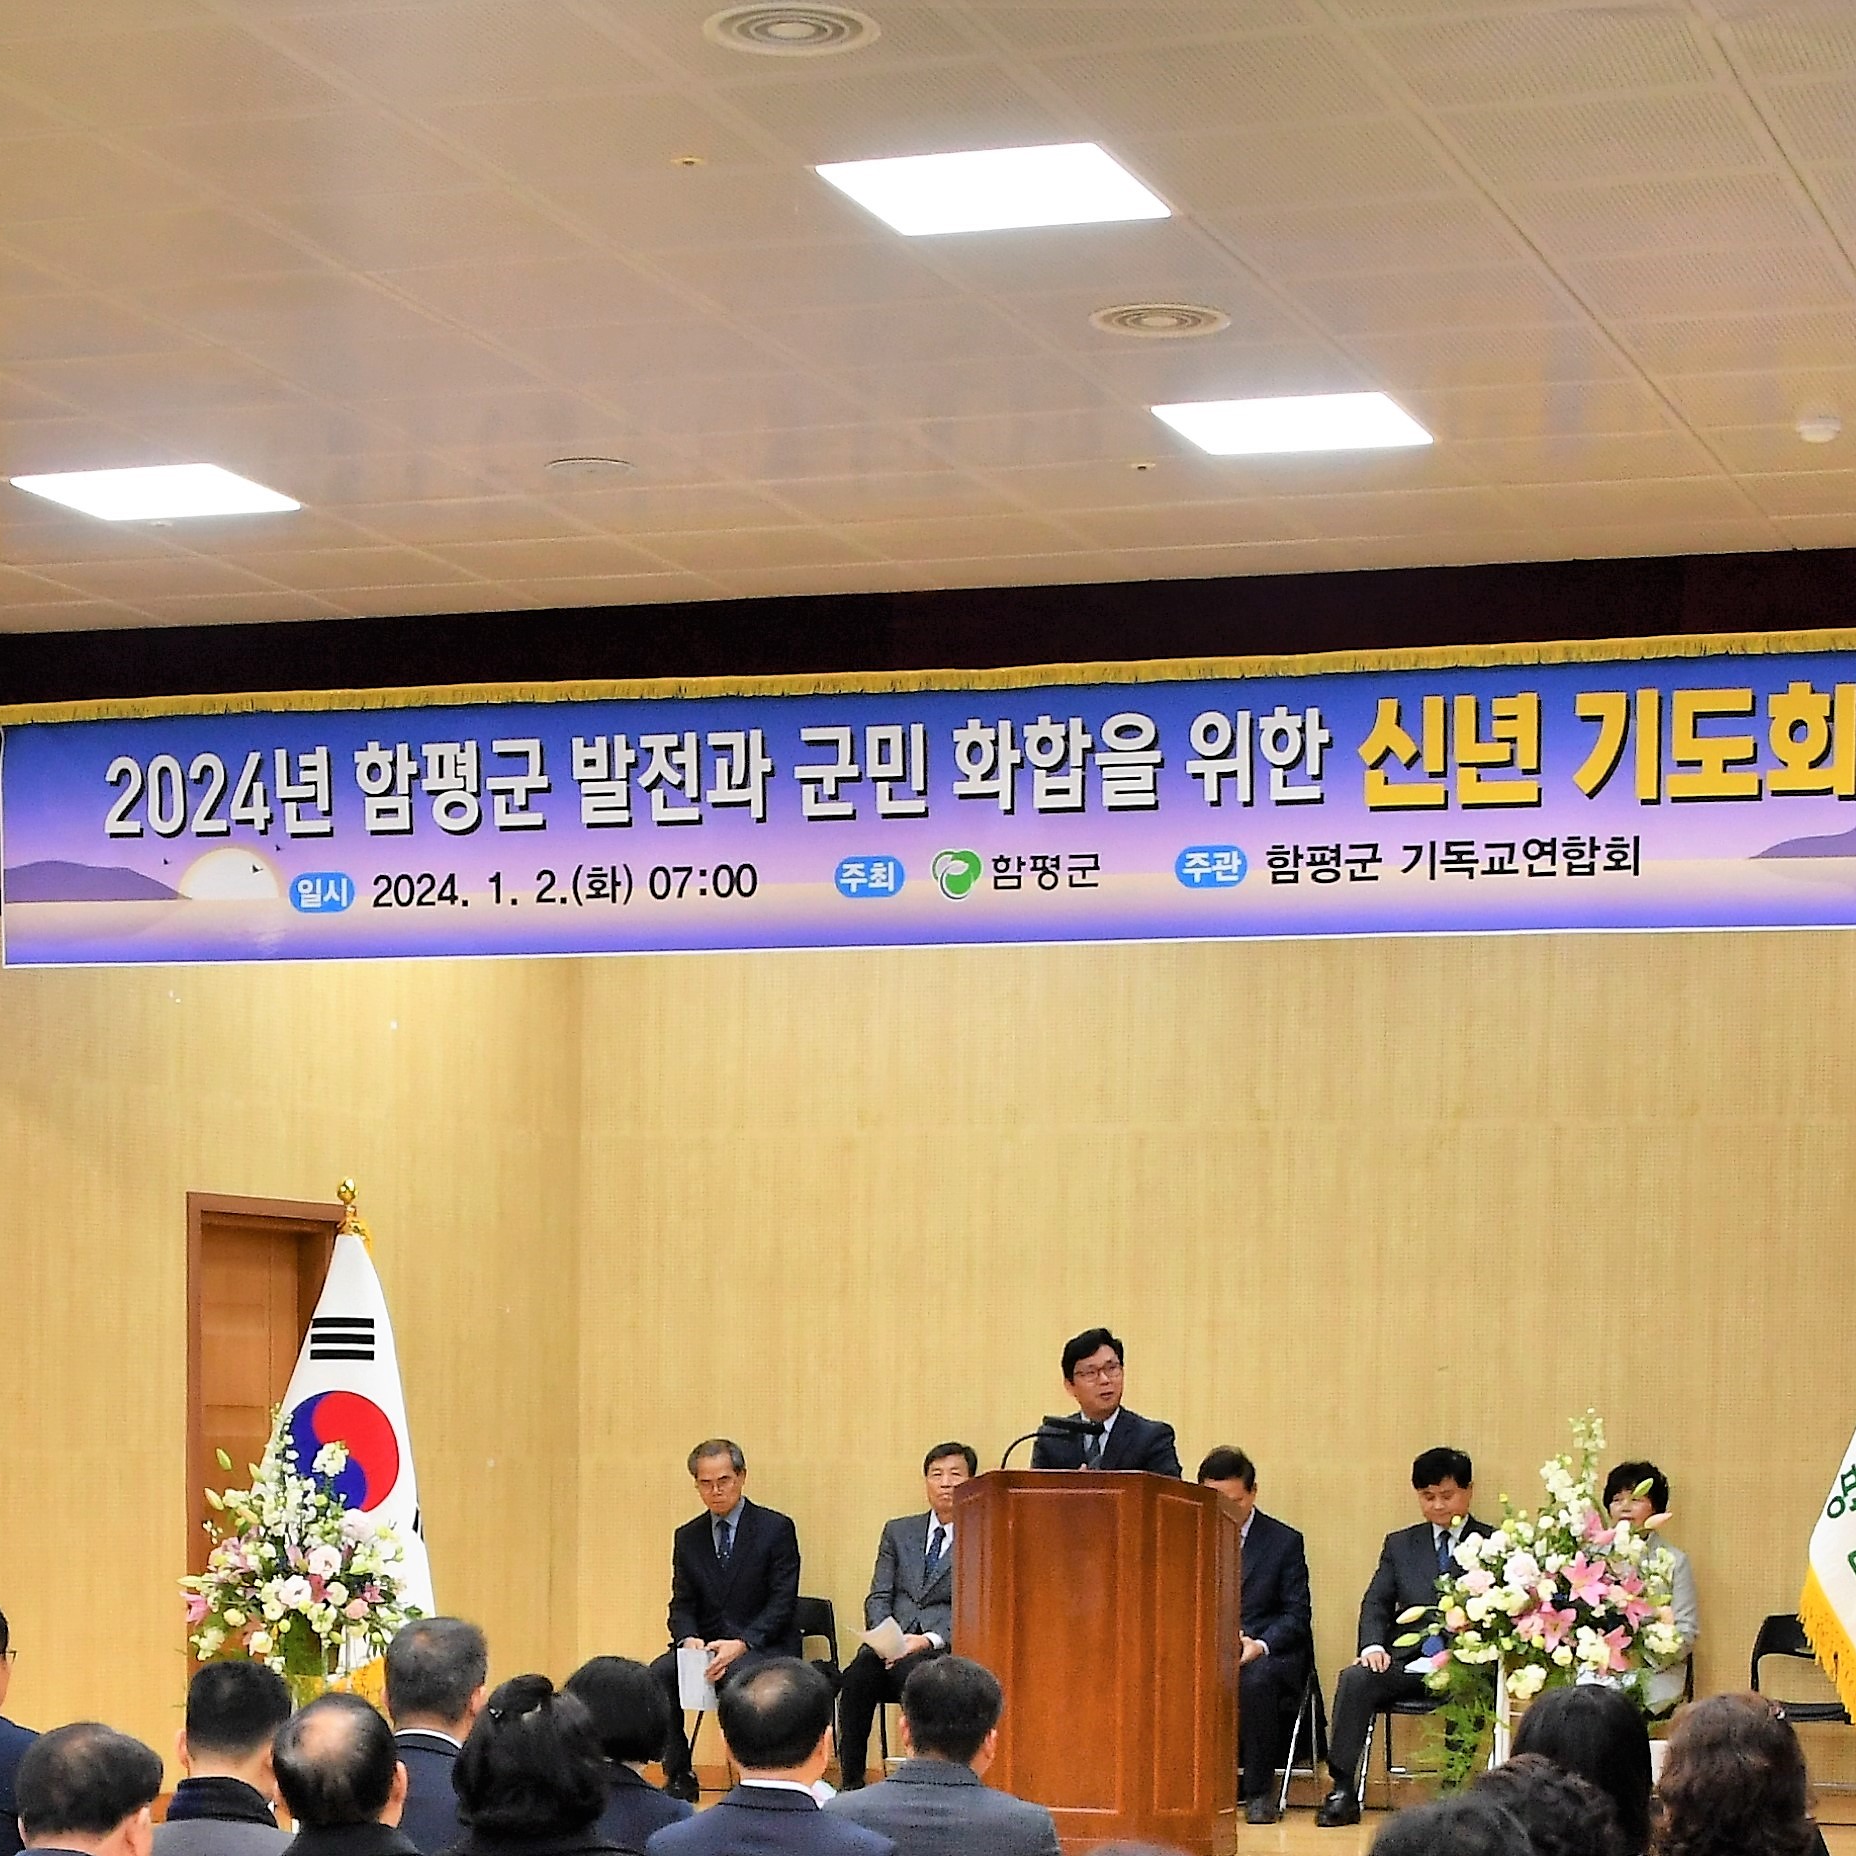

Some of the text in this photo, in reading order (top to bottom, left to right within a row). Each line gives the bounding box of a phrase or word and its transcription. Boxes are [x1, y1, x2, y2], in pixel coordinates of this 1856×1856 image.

[104, 746, 332, 839] 2024년
[354, 738, 550, 835] 함평군
[572, 729, 773, 828] 발전과
[794, 723, 929, 821] 군민
[953, 712, 1163, 815] 화합을
[1186, 706, 1330, 806] 위한
[1358, 690, 1541, 810] 신년
[839, 853, 1101, 893] 주최 함평군
[1181, 835, 1640, 885] 주관 함평군 기독교연합회
[297, 863, 758, 908] 일시 2024. 1. 2.(화) 07:00
